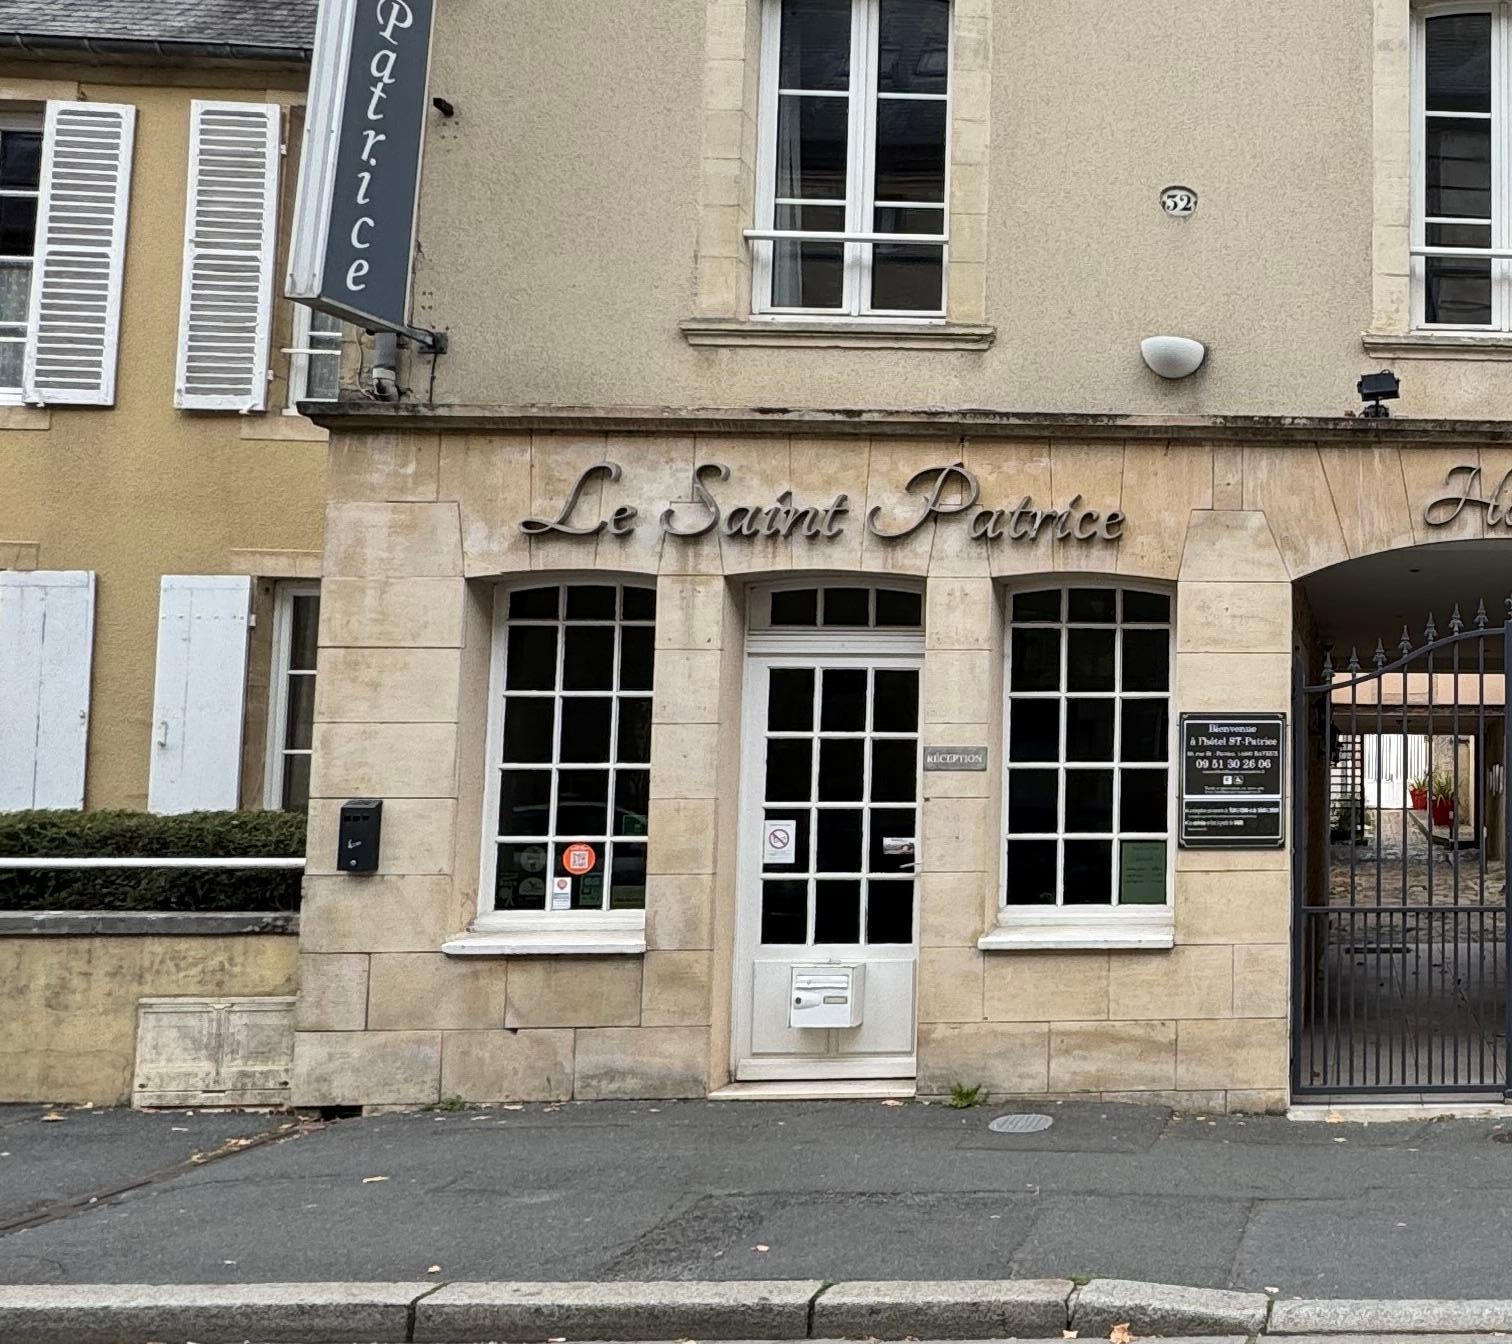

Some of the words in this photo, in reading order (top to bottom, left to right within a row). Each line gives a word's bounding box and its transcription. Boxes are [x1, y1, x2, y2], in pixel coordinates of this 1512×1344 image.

[1167, 194, 1192, 212] 52
[517, 461, 638, 537] Le
[658, 462, 849, 539] Saint
[867, 461, 1126, 541] Patrice
[1208, 724, 1257, 733] Bienvenue
[1196, 759, 1209, 768] 09
[1212, 759, 1224, 768] 51
[1227, 759, 1240, 768] 30
[1243, 759, 1255, 768] 26
[1258, 759, 1271, 768] 06
